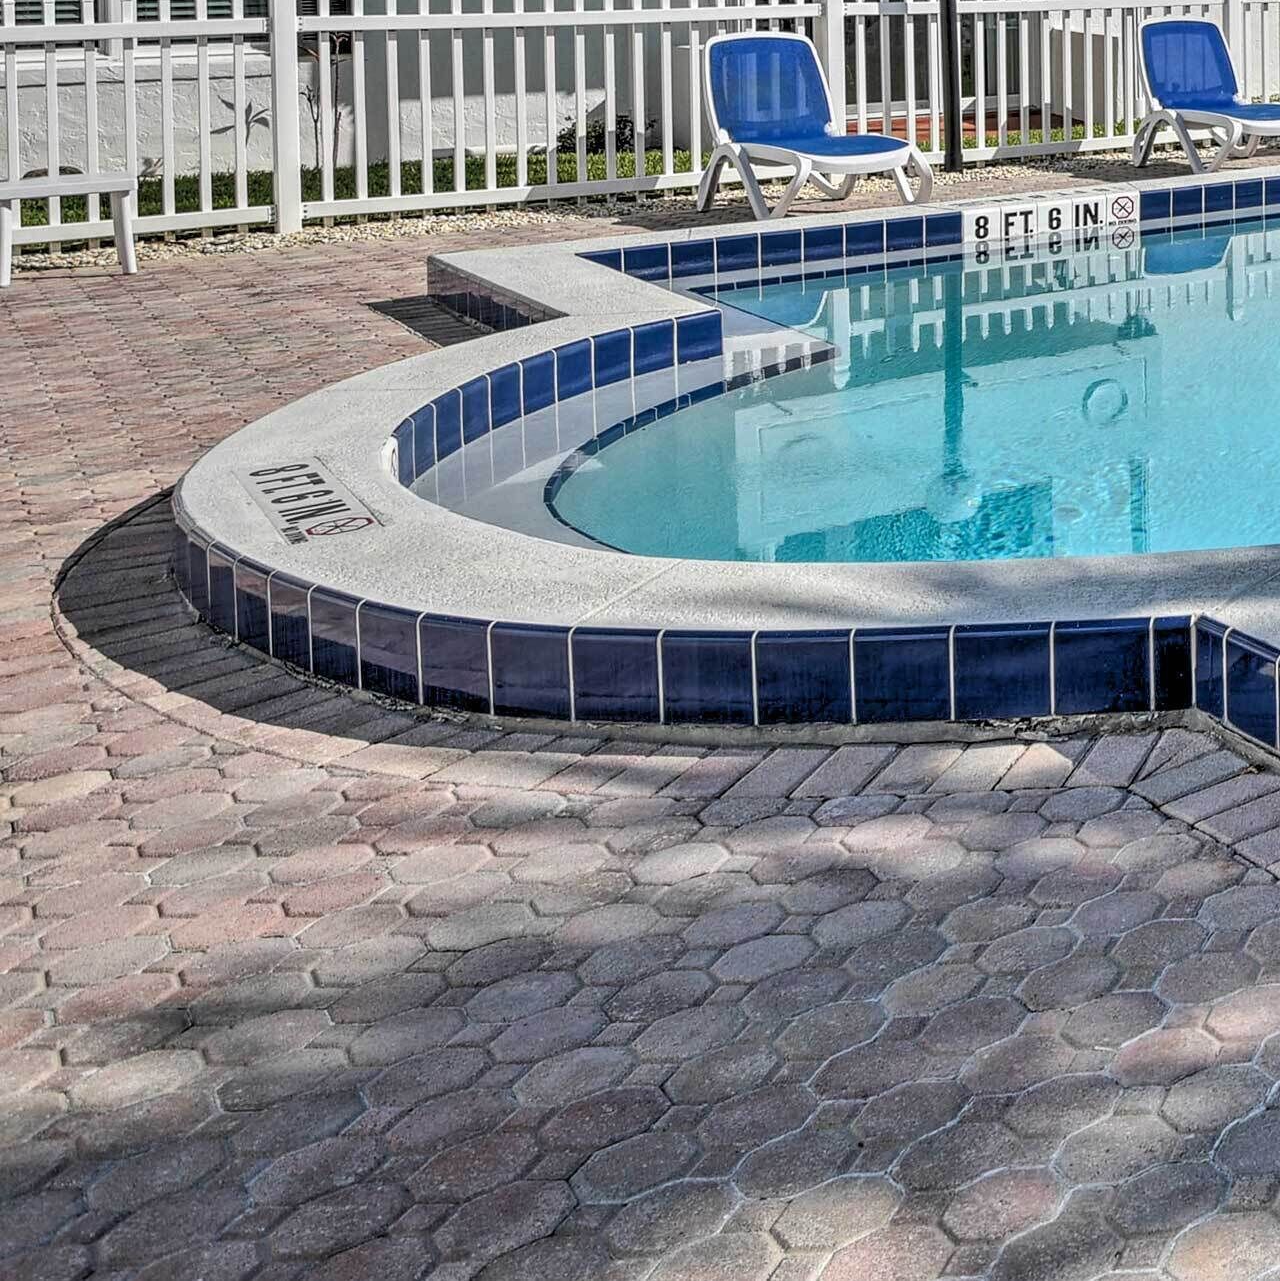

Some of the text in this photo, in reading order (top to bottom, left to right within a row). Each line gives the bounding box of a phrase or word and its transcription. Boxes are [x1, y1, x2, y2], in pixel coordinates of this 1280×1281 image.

[974, 202, 1103, 240] 8 FT. 6 IN.
[249, 463, 309, 477] 8
[256, 472, 326, 494] FT.
[271, 489, 334, 504] 6
[278, 499, 351, 525] IN.
